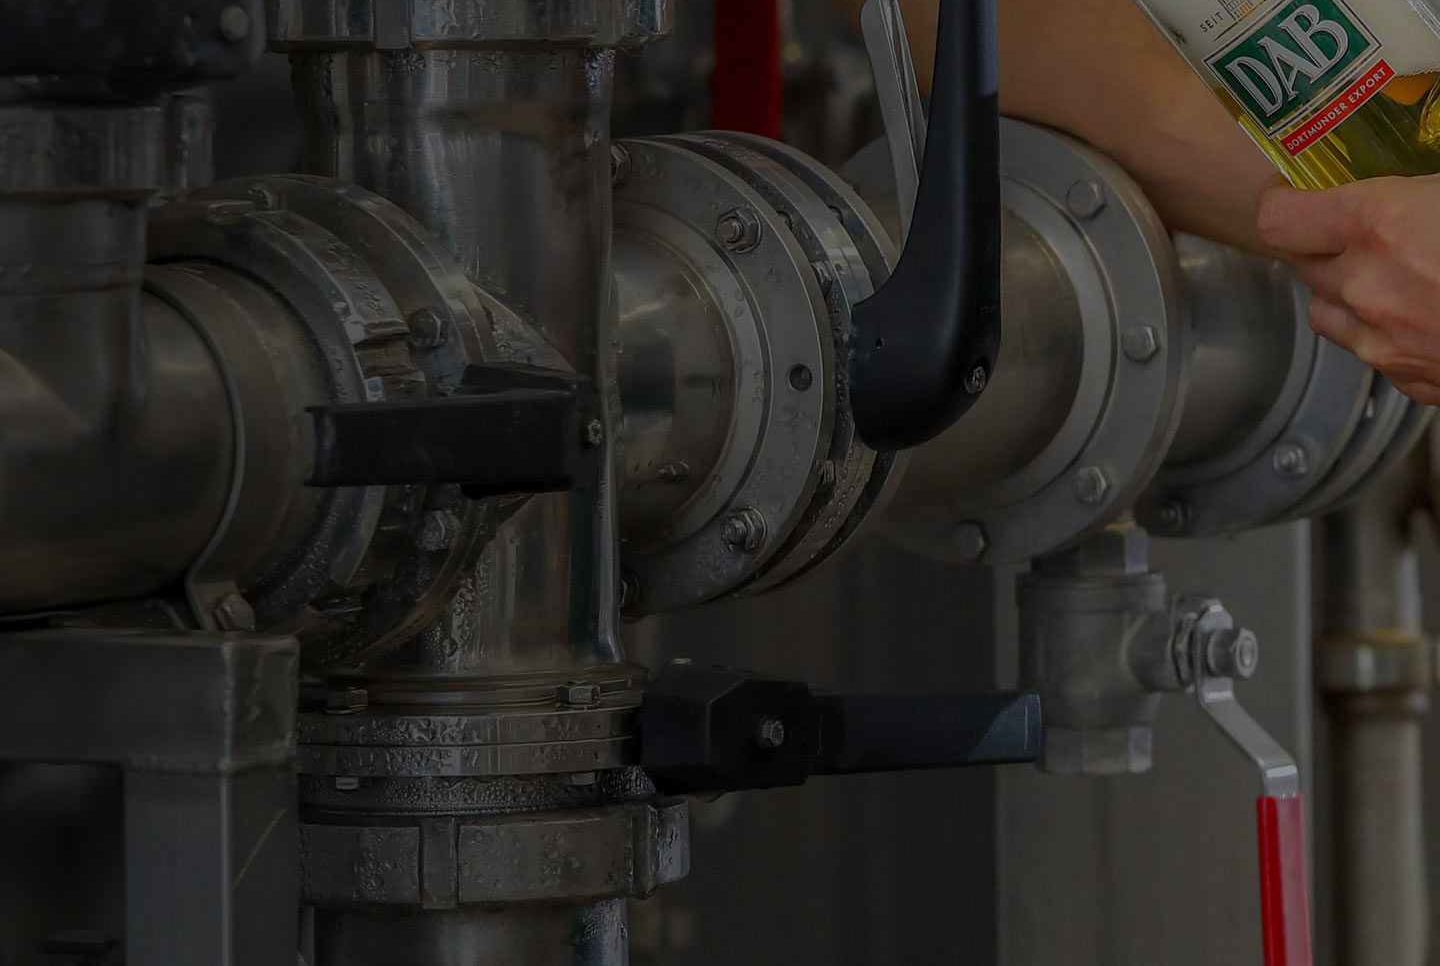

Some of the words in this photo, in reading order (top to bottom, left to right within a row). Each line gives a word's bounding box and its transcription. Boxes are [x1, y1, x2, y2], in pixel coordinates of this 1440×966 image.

[1199, 11, 1224, 33] SEIT
[1225, 2, 1349, 118] DAB
[1286, 102, 1349, 151] DORTMUNDER
[1347, 66, 1388, 104] EXPORT
